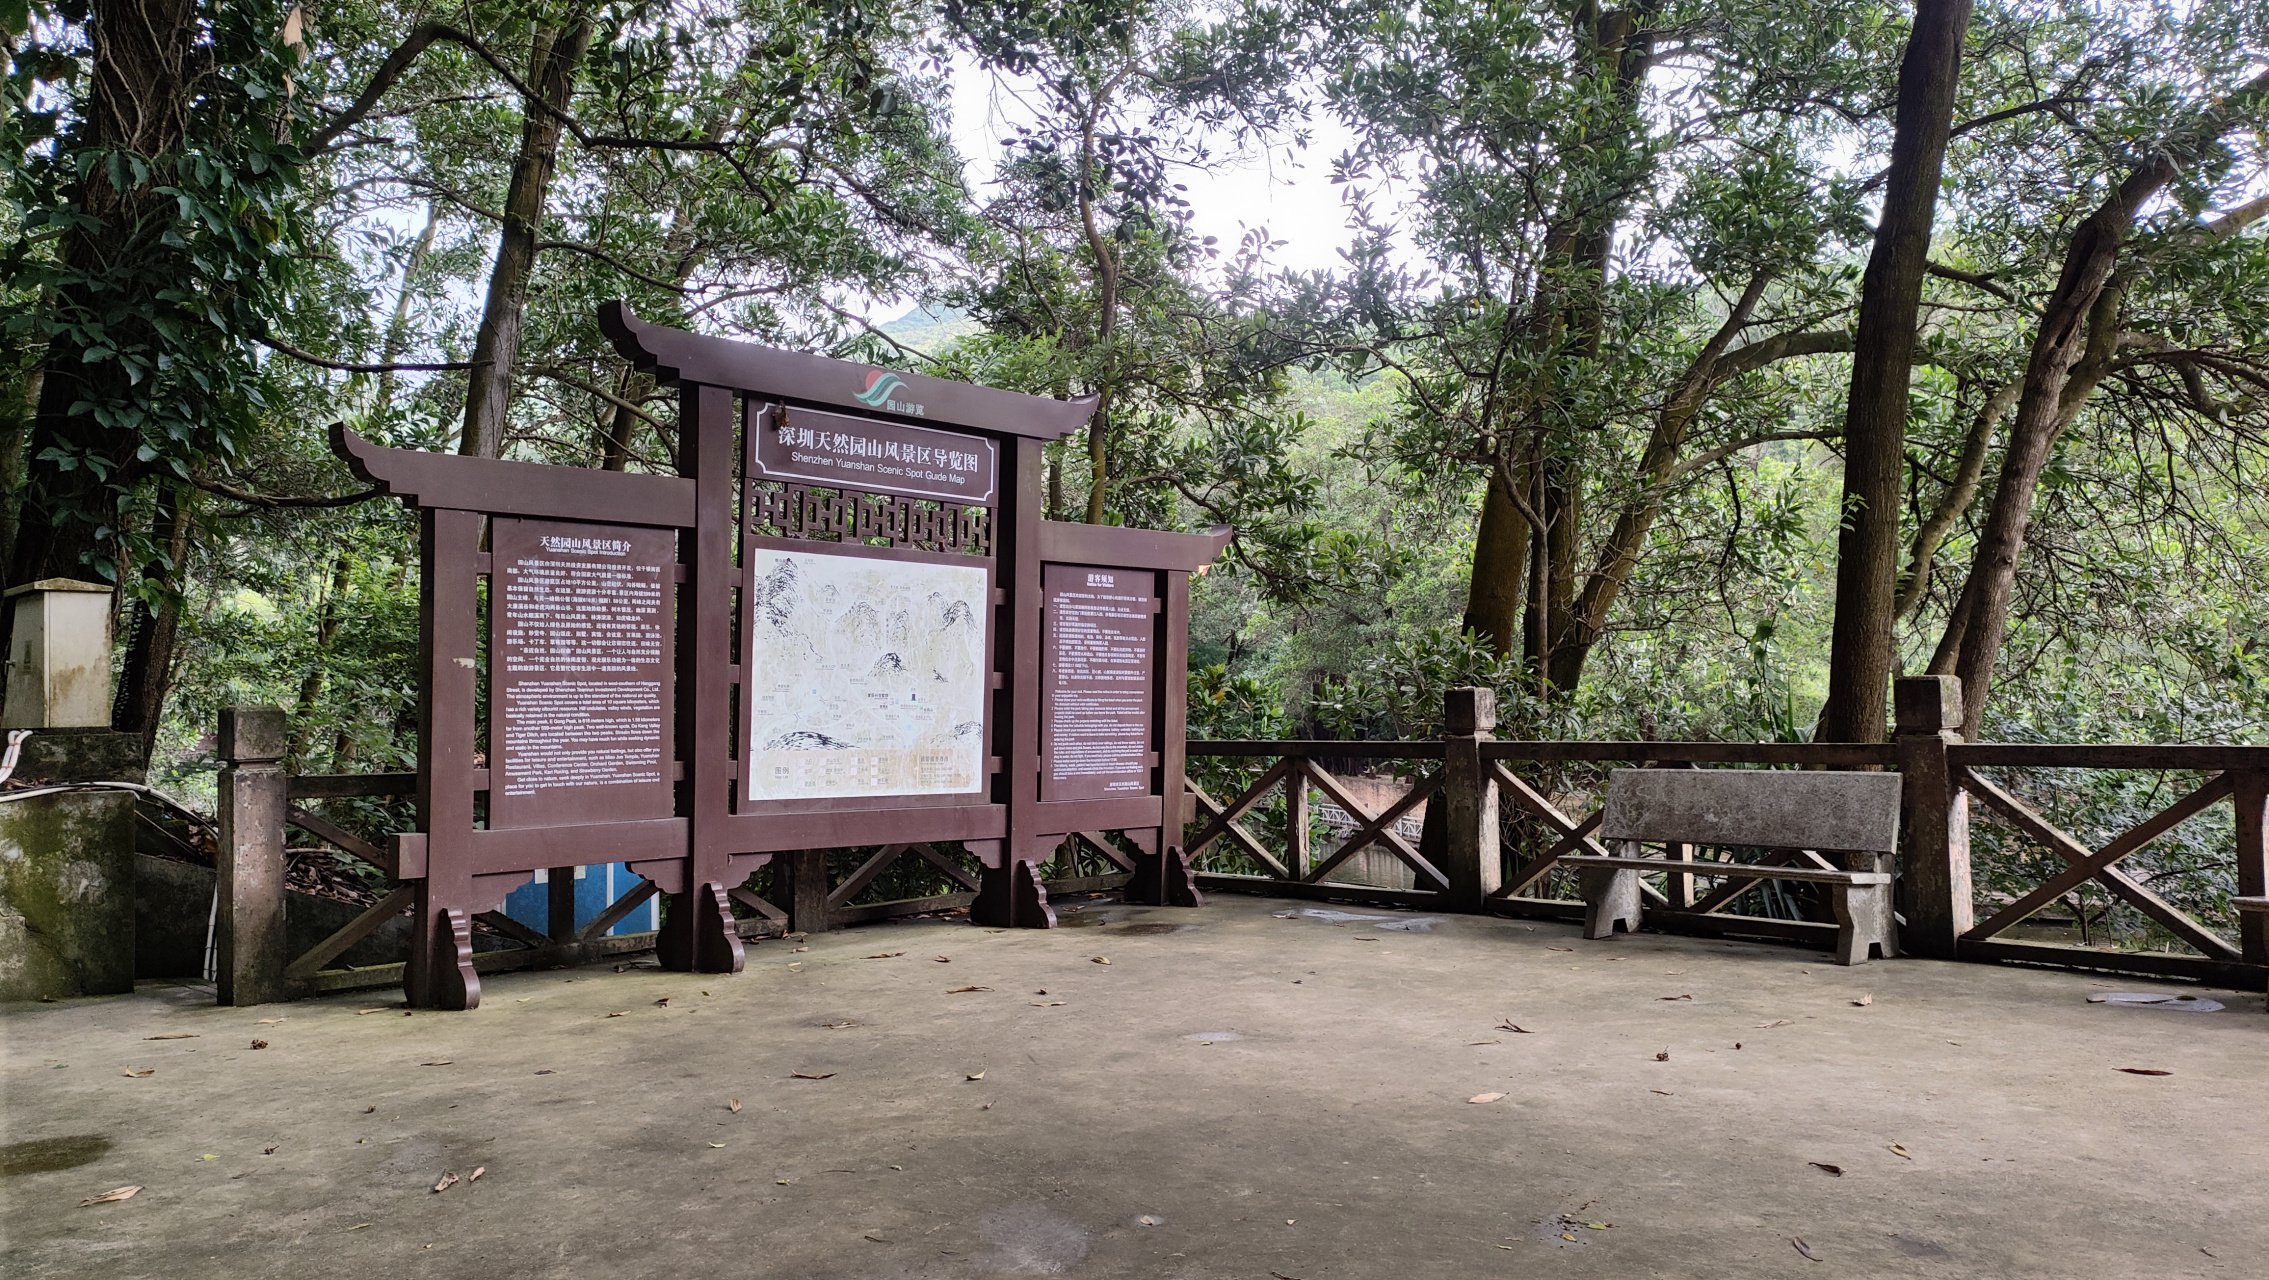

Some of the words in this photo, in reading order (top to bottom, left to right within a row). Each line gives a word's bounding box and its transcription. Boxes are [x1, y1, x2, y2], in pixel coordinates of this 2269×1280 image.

[779, 426, 978, 472] 深圳天然园山风景区导览图
[792, 452, 833, 466] Shenzhen
[836, 458, 874, 472] Yuanshan
[878, 464, 903, 476] Scenic
[906, 467, 923, 479] Spot
[926, 470, 946, 481] Guide
[949, 473, 965, 485] Map
[540, 536, 631, 552] 天然园山风景区简介
